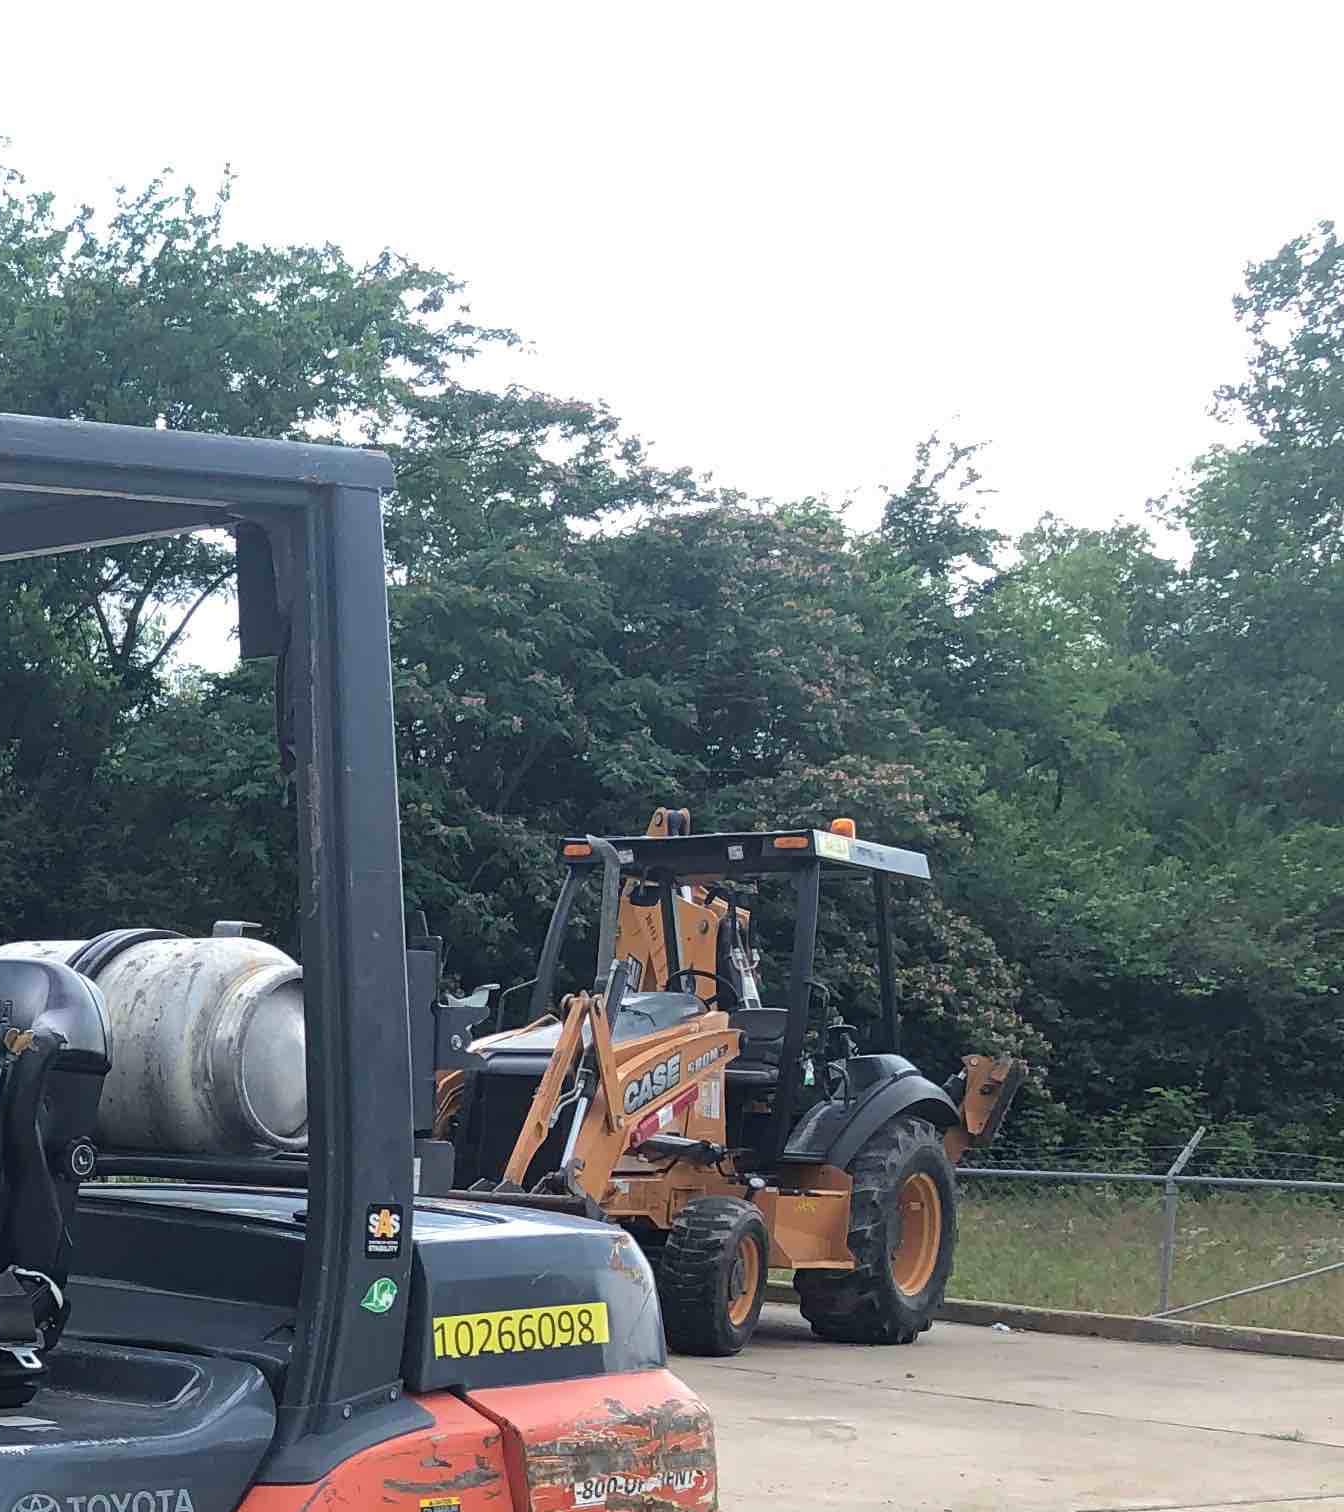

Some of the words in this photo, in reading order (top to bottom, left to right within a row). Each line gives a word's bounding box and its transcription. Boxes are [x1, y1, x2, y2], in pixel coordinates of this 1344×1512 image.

[624, 1052, 681, 1114] CASE
[368, 1209, 401, 1238] SAS
[433, 1308, 595, 1359] 10266098
